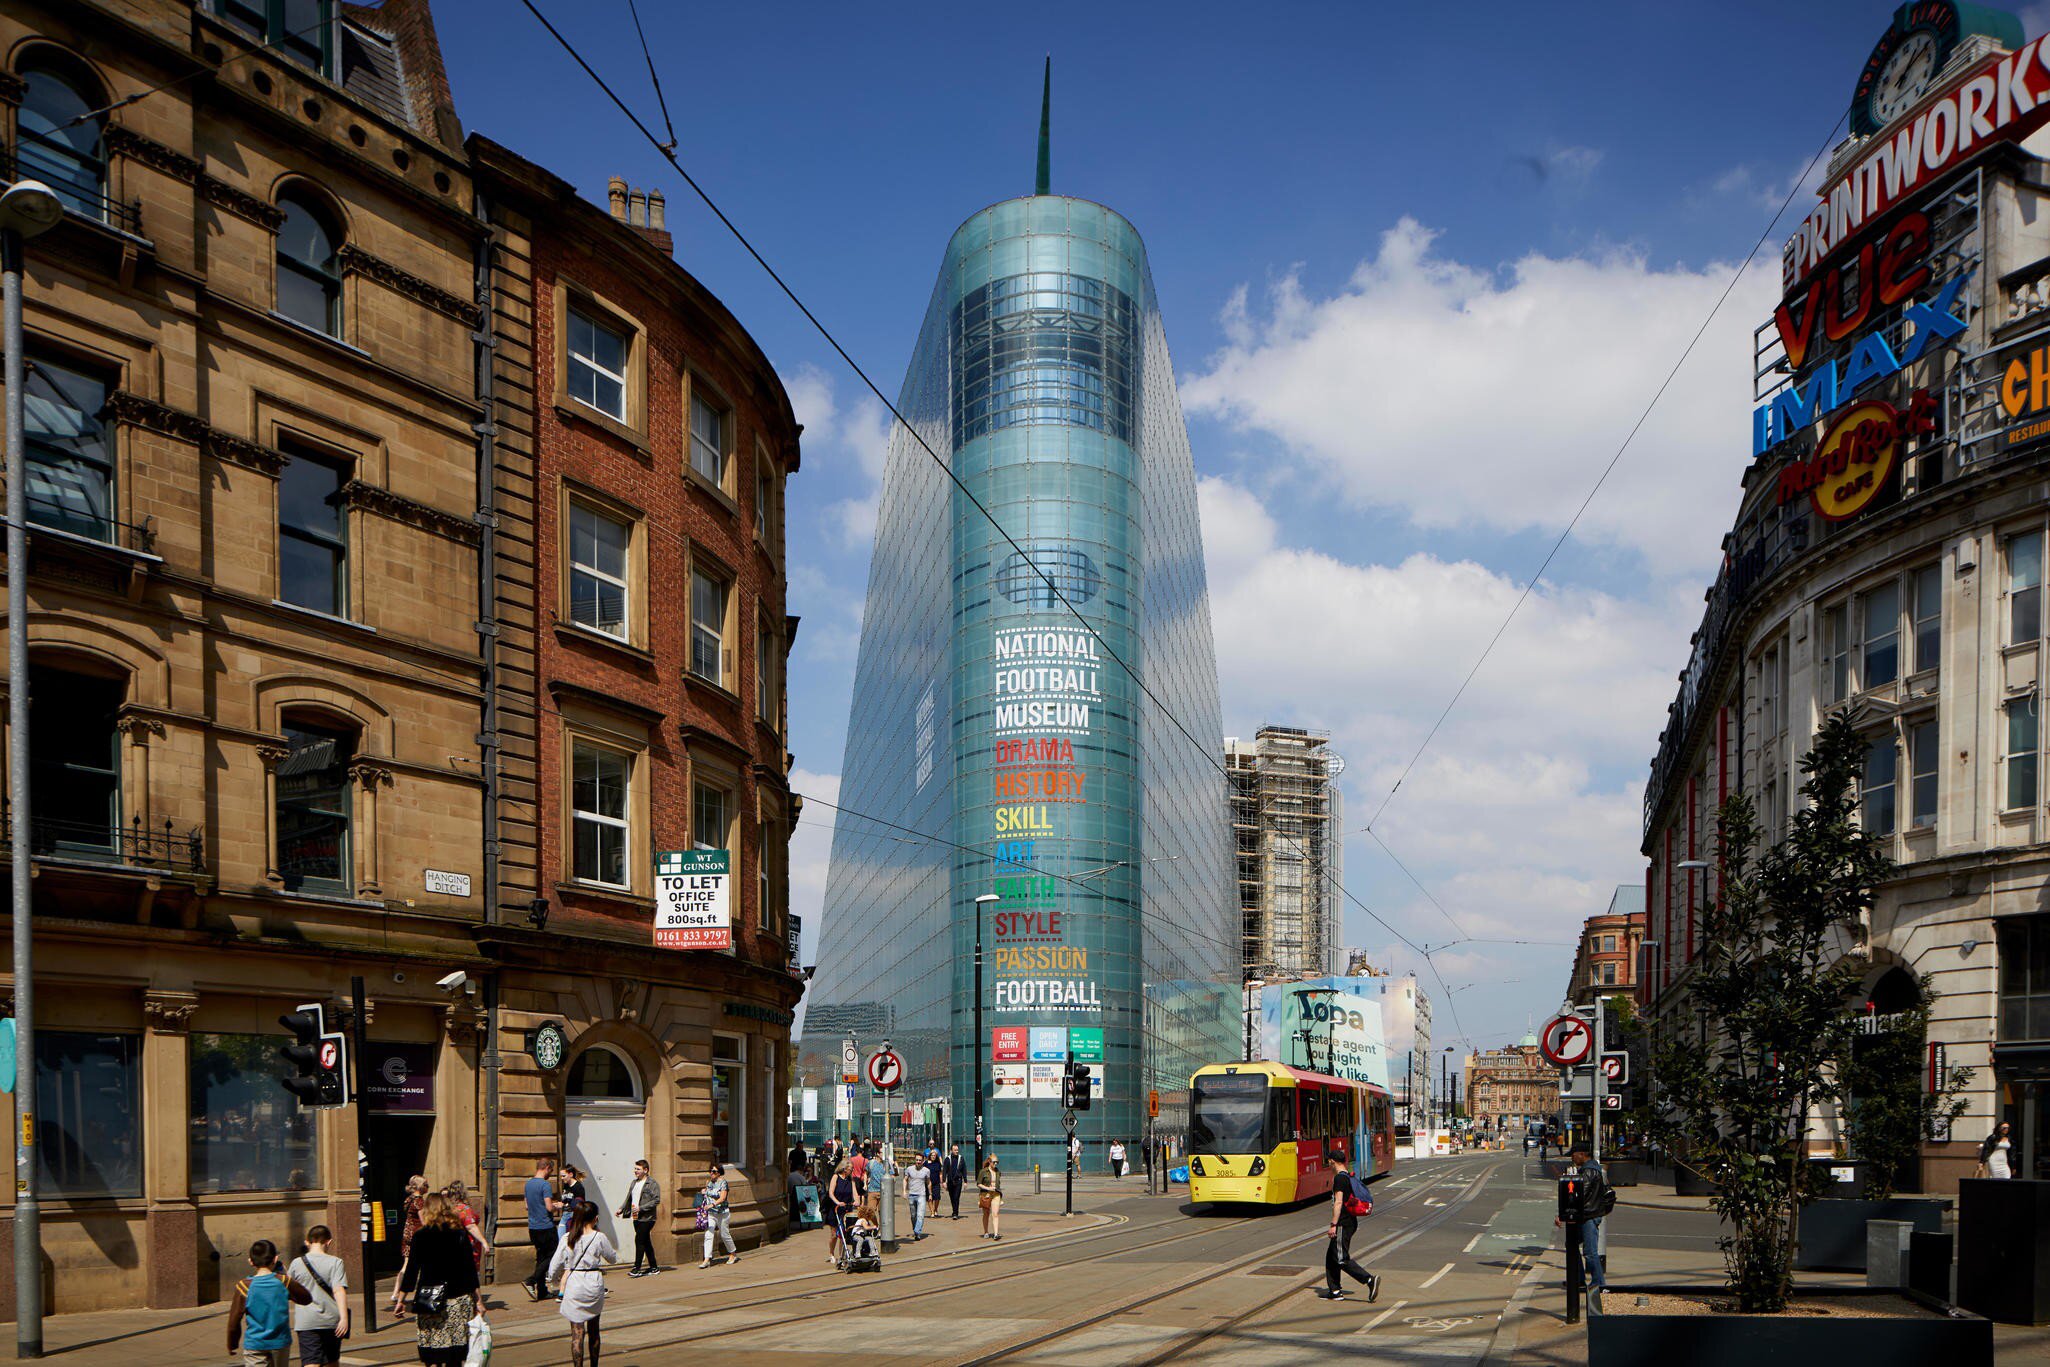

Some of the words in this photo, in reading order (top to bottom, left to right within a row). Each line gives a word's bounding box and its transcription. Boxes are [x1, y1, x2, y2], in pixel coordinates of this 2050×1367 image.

[1753, 273, 1974, 457] IMAX
[2009, 418, 2050, 444] RESTAU
[1833, 470, 1874, 502] CAFE
[995, 632, 1100, 661] NATIONAL
[995, 667, 1101, 695] FOOTBALL
[995, 701, 1089, 729] MUSEUM
[995, 737, 1075, 763] DRAMA
[995, 770, 1087, 797] HISTORY
[995, 805, 1054, 832] SKILL
[696, 854, 713, 862] WT
[995, 840, 1036, 866] ART
[683, 862, 726, 871] GUNSON
[427, 871, 469, 886] HANGING
[434, 882, 463, 894] DITCH
[662, 877, 684, 890] TO
[690, 876, 723, 889] LET
[995, 877, 1055, 900] FAITH
[668, 891, 716, 902] OFFICE
[674, 902, 710, 913] SUITE
[667, 914, 718, 926] 800sq.ft
[995, 911, 1062, 936] STYLE
[657, 931, 680, 941] 0161
[683, 931, 701, 941] 833
[703, 930, 728, 941] 9797
[789, 931, 799, 942] ET
[996, 946, 1088, 971] PASSION
[996, 980, 1101, 1005] FOOTBALL
[999, 1041, 1019, 1049] ENTRY
[1040, 1032, 1058, 1040] OPEN
[1040, 1040, 1058, 1048] DAILY
[1309, 1033, 1340, 1046] estae
[1343, 1040, 1377, 1055] agent
[1065, 1117, 1075, 1126] 15
